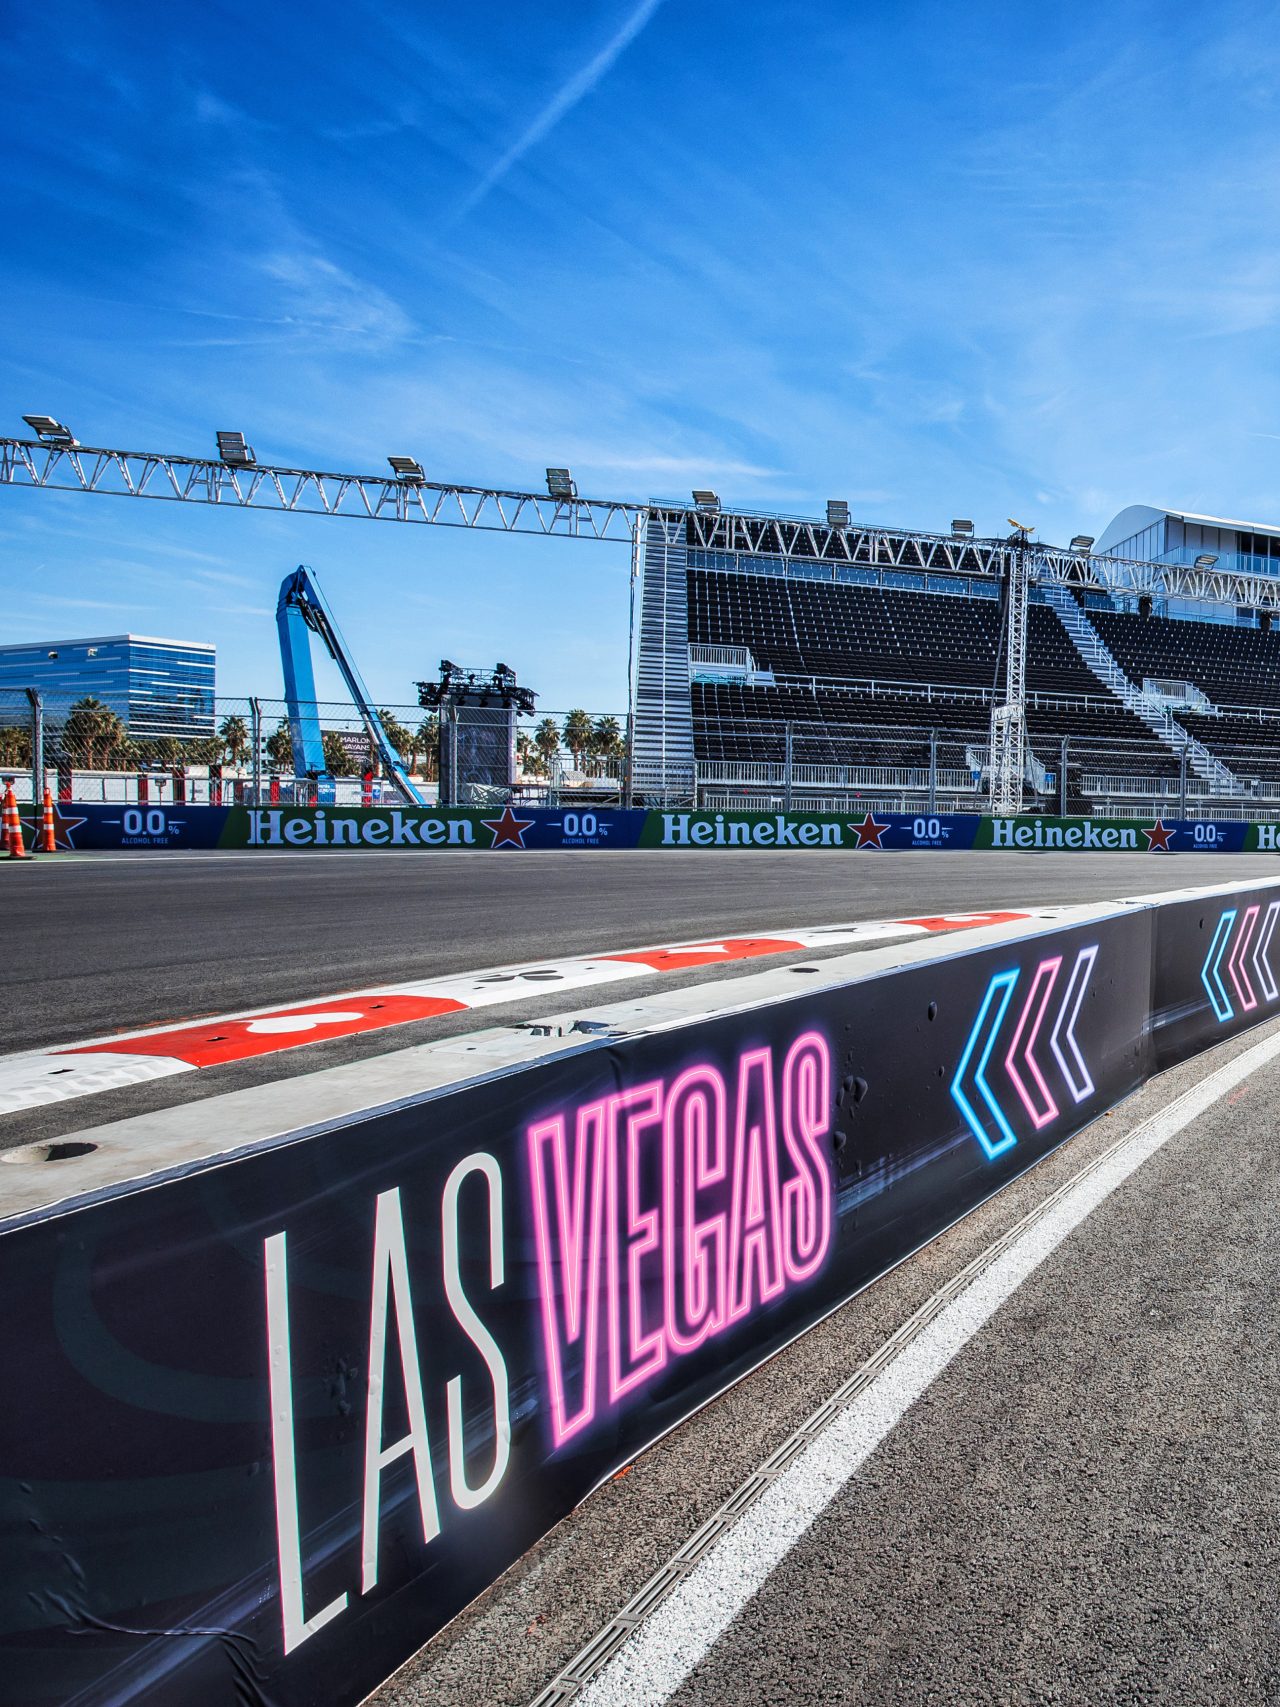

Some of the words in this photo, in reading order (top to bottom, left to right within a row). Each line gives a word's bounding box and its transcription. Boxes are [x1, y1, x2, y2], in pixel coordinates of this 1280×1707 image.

[121, 837, 151, 845] ALCOHOL
[153, 837, 169, 845] FREE
[246, 810, 476, 845] Heineken
[661, 814, 843, 845] Heineken
[991, 819, 1138, 848] Heineken
[264, 1152, 512, 1656] LAS
[526, 1030, 833, 1451] VEGAS
